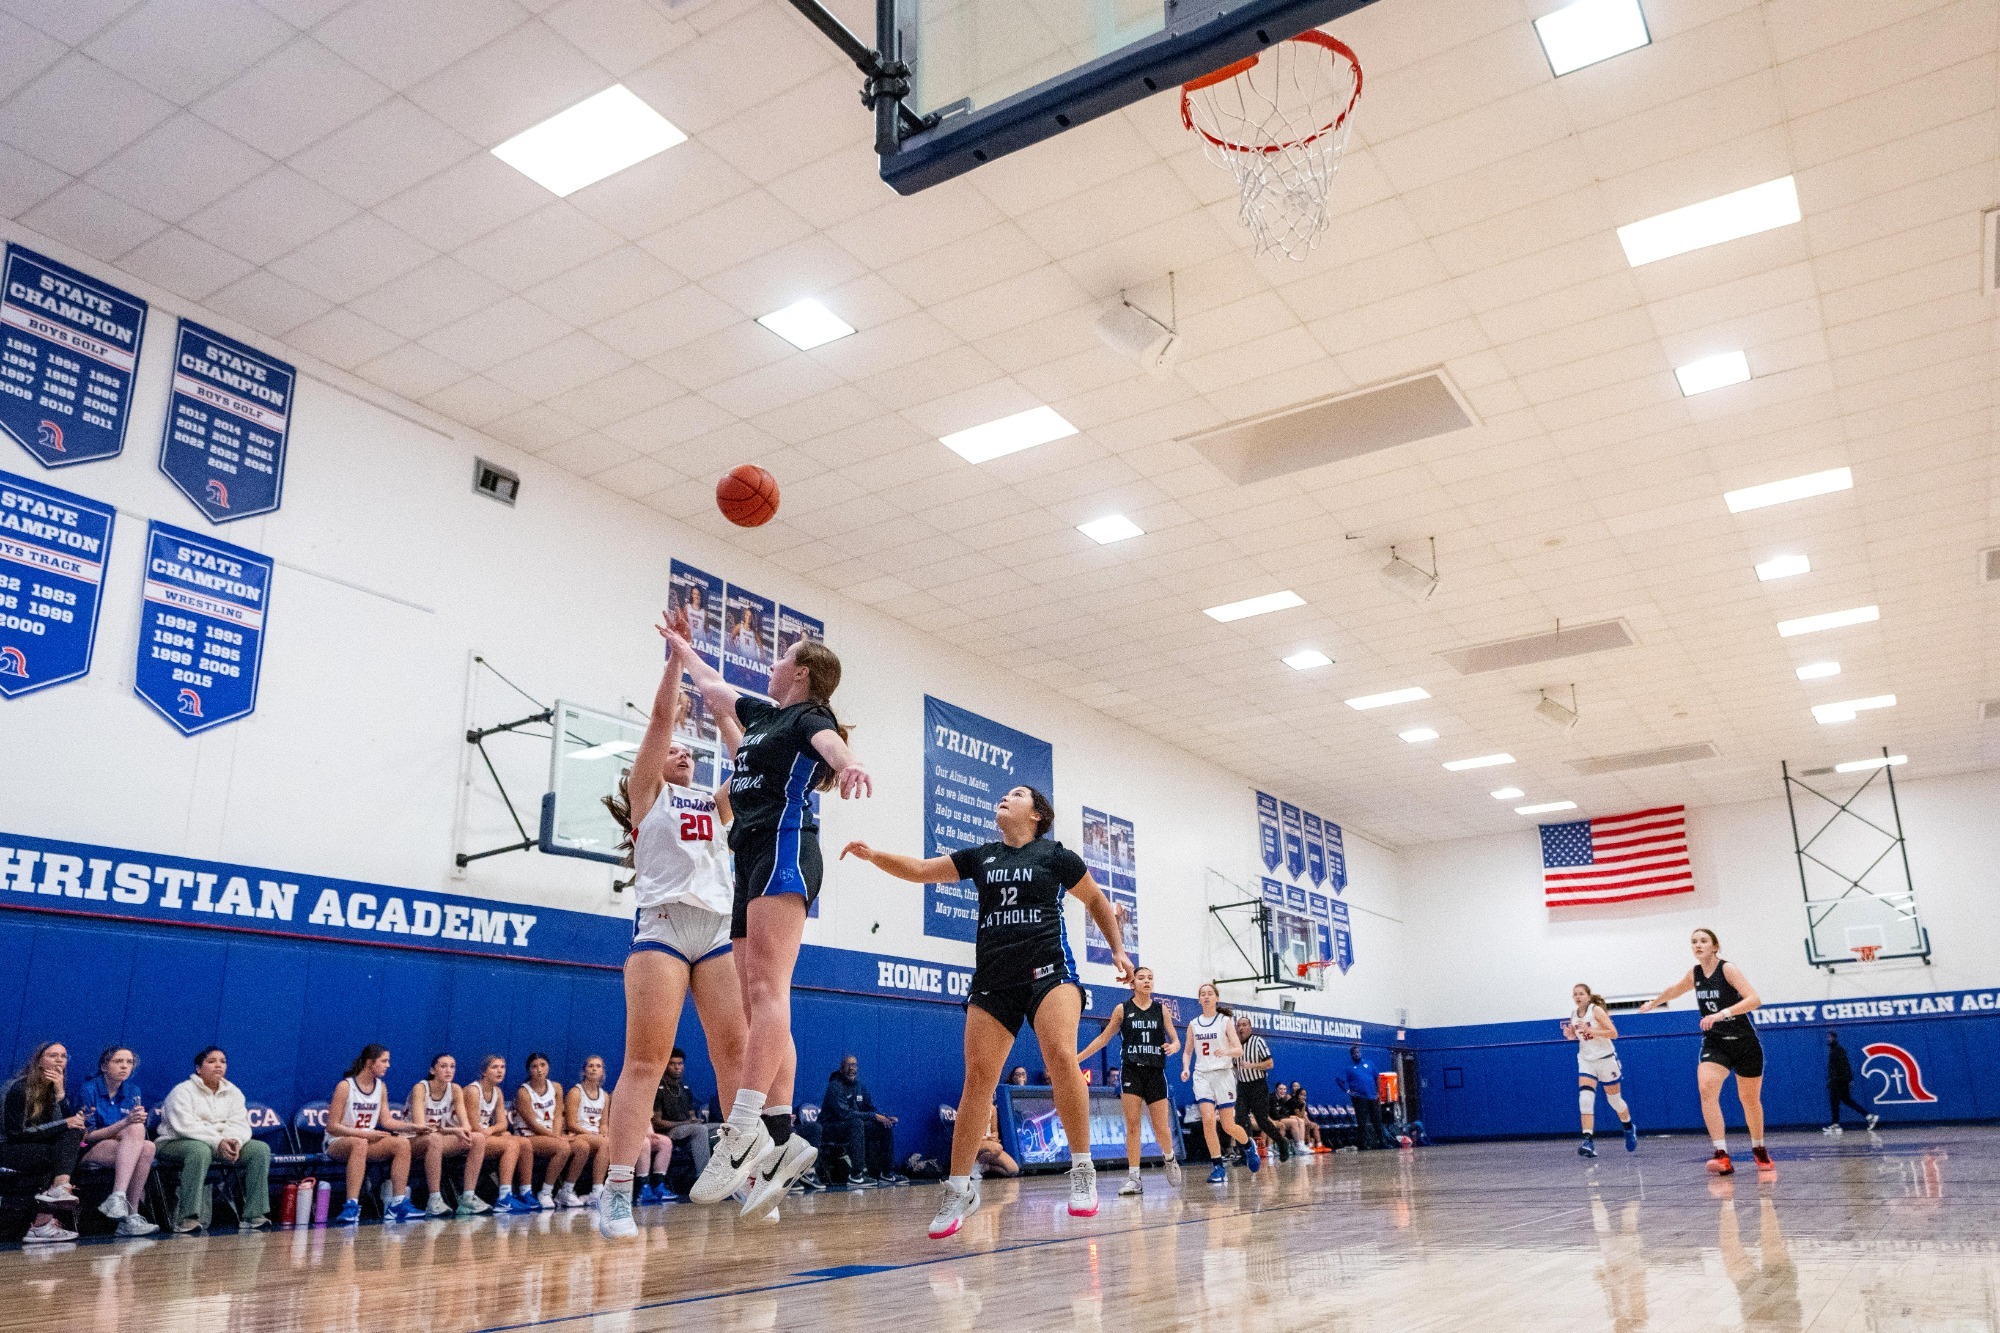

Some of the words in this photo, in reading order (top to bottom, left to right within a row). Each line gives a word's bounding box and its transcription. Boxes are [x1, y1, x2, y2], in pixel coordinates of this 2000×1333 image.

[40, 274, 113, 316] STATE
[10, 281, 133, 344] CHAMPION
[29, 319, 68, 340] BOYS
[71, 336, 108, 356] GOLF
[2, 351, 37, 372] 1994
[6, 338, 38, 357] 1991
[48, 353, 80, 373] 1992
[205, 345, 267, 382] STATE
[0, 365, 34, 384] 1997
[181, 353, 285, 407] CHAMPION
[39, 396, 74, 416] 2010
[82, 411, 113, 430] 2011
[197, 386, 230, 406] BOYS
[233, 402, 264, 419] GOLF
[248, 431, 275, 448] 2017
[244, 457, 273, 475] 2024
[1, 490, 78, 527] STATE
[0, 542, 24, 557] YS
[29, 551, 81, 573] TRACK
[177, 546, 242, 578] STATE
[152, 558, 261, 602] CHAMPION
[31, 583, 77, 606] 1983
[165, 590, 242, 619] WRESTLING
[28, 601, 74, 624] 1999
[156, 612, 197, 634] 1992
[205, 625, 243, 646] 1993
[153, 629, 195, 650] 1994
[203, 641, 241, 662] 1995
[691, 639, 720, 657] JANS
[151, 645, 193, 666] 1999
[199, 657, 240, 678] 2006
[172, 667, 213, 688] 2015
[935, 725, 1014, 775] TRINITY,
[935, 764, 949, 779] Our
[949, 770, 968, 785] Alma
[935, 784, 945, 796] As
[946, 789, 957, 800] we
[957, 790, 976, 806] learn
[976, 796, 992, 811] from
[680, 812, 713, 842] 20
[935, 803, 952, 819] Help
[953, 810, 962, 820] us
[962, 813, 971, 823] as
[972, 816, 982, 826] we
[983, 817, 997, 831] look
[935, 822, 945, 835] As
[946, 826, 956, 838] He
[957, 828, 975, 843] leads
[976, 836, 984, 846] us
[986, 868, 1032, 884] NOLAN
[1000, 887, 1018, 907] 12
[309, 888, 536, 947] ACADEMY
[935, 902, 952, 917] May
[952, 907, 970, 918] your
[878, 961, 942, 993] HOME
[947, 971, 973, 997] OF
[1697, 989, 1720, 1000] NOLAN
[1705, 1000, 1718, 1012] 13
[1822, 996, 1955, 1020] CHRISTIAN
[1132, 1020, 1157, 1030] NOLAN
[1141, 1031, 1150, 1043] 11
[1273, 1014, 1322, 1036] CHRISTIAN
[1323, 1021, 1362, 1039] ACADEMY
[1127, 1045, 1162, 1056] CATHOLIC
[1201, 1042, 1210, 1056] 2
[247, 1108, 281, 1128] CA
[303, 1109, 329, 1127] TC
[355, 1113, 372, 1128] 22
[802, 1108, 821, 1122] TC
